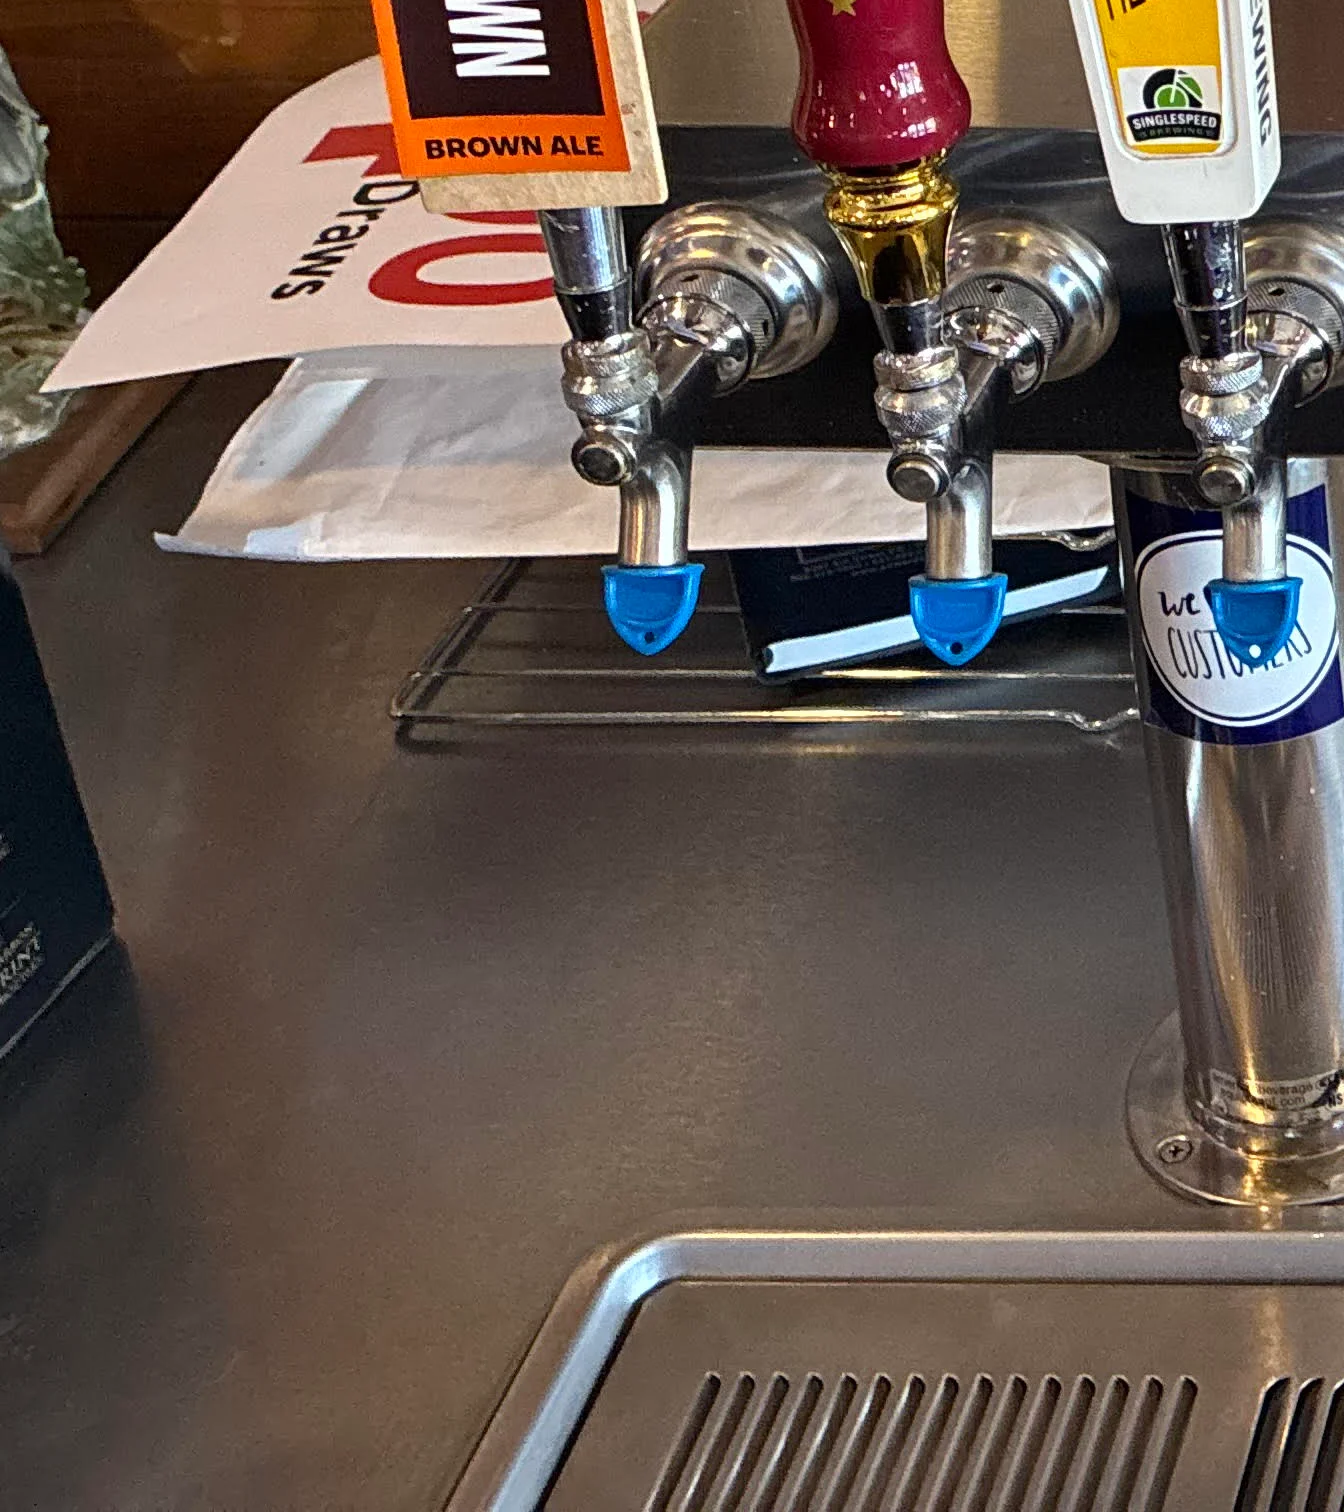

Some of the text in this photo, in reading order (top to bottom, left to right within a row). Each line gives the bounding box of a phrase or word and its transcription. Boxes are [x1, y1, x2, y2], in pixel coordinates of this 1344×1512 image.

[1132, 113, 1218, 130] SINGLESPEED
[425, 136, 543, 159] BROWN
[550, 135, 604, 157] ALE
[271, 180, 421, 300] Draws
